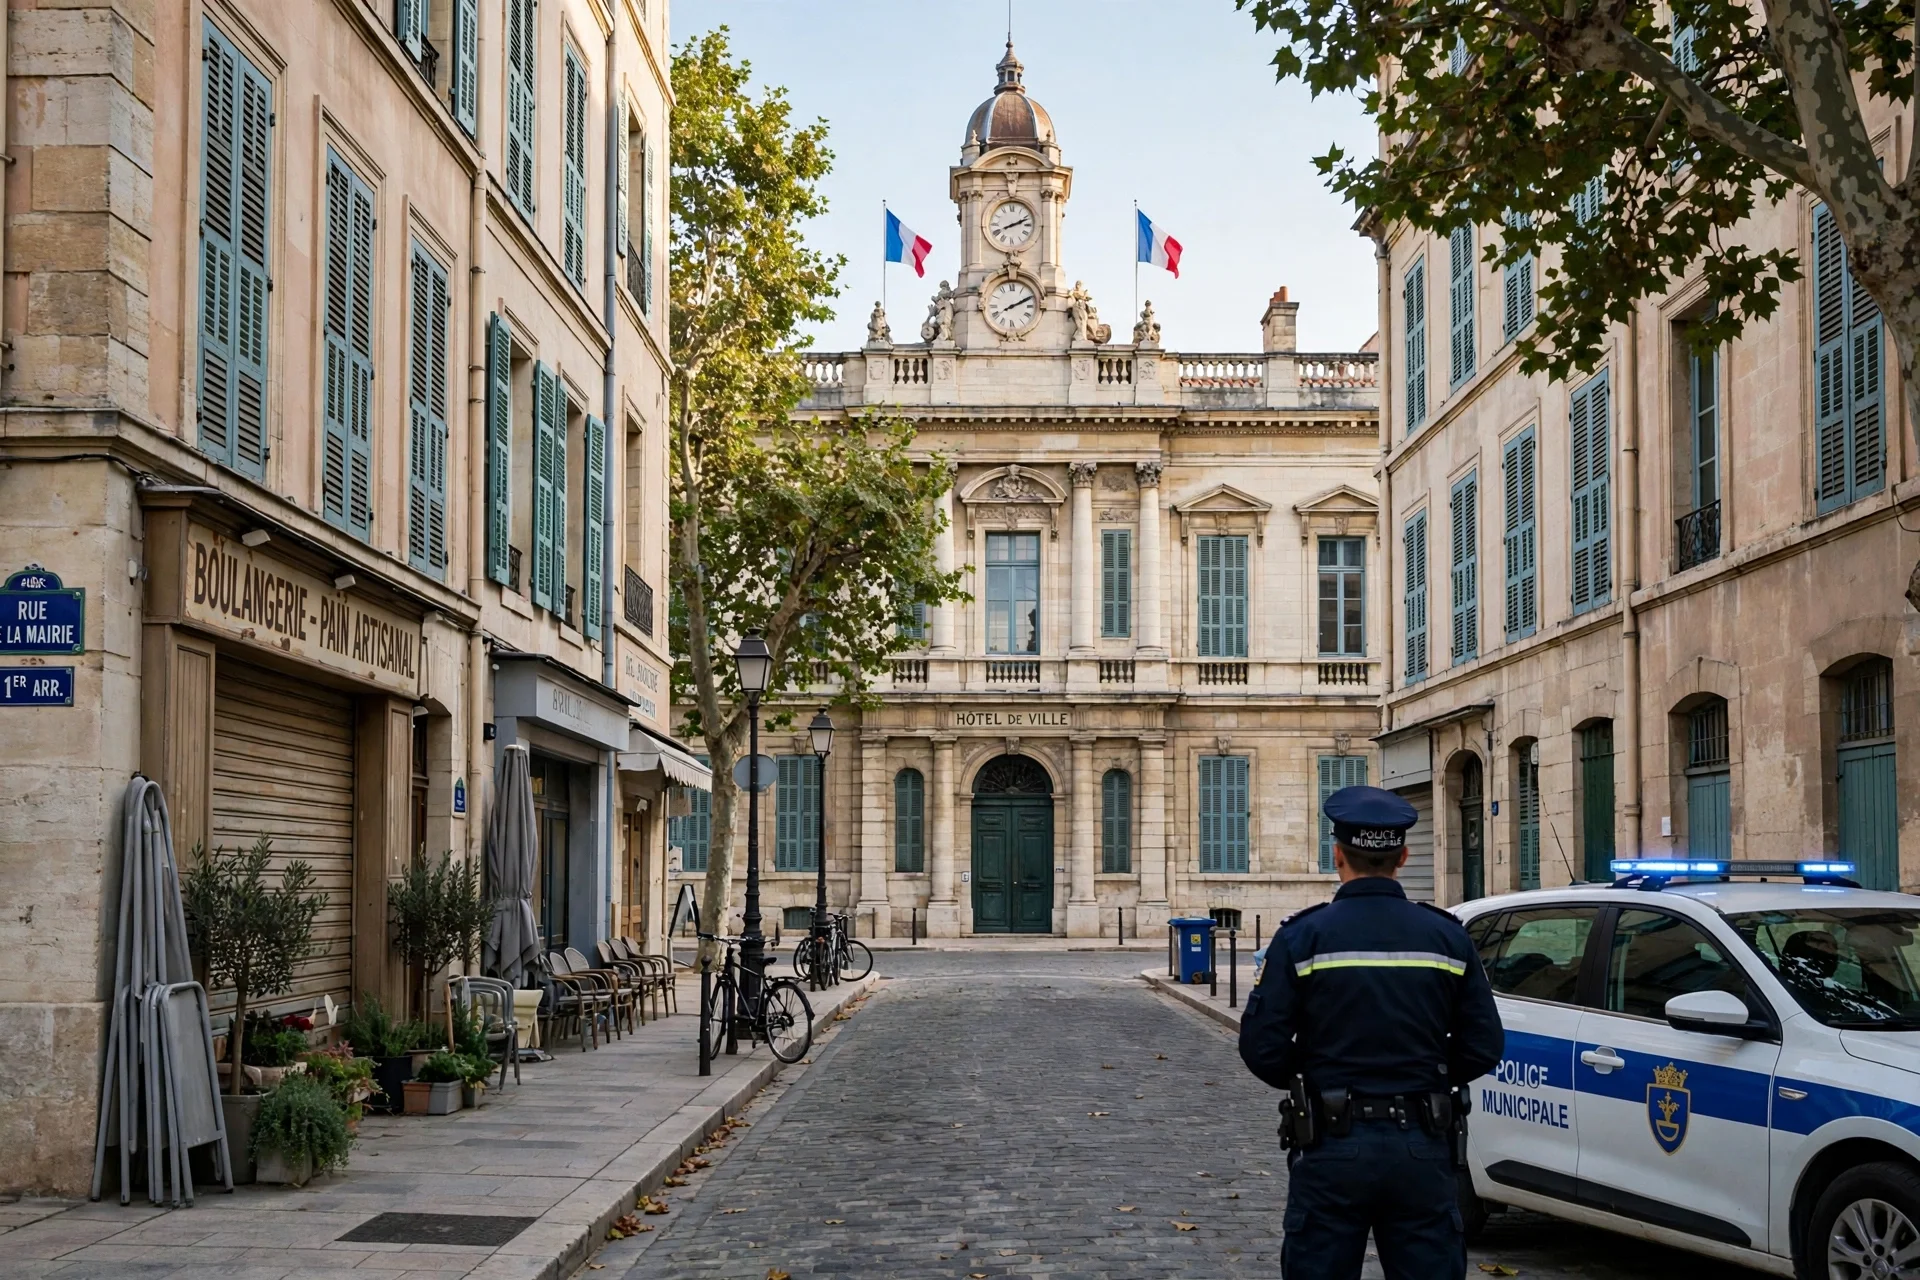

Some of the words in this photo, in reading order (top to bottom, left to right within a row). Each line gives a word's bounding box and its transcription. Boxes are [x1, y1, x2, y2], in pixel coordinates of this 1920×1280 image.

[18, 600, 48, 620] RUE
[194, 542, 308, 641] BOULANGERIE
[320, 596, 350, 656] PAIN
[352, 611, 415, 679] ARTISANAL
[6, 625, 21, 644] LA
[26, 624, 74, 644] MAIRIE
[32, 679, 64, 697] ARR.
[956, 711, 1002, 725] HÔTEL
[1008, 714, 1023, 725] DE
[1028, 713, 1068, 725] VILLE
[1496, 1059, 1549, 1089] POLICE
[1482, 1088, 1570, 1129] MUNICIPALE
